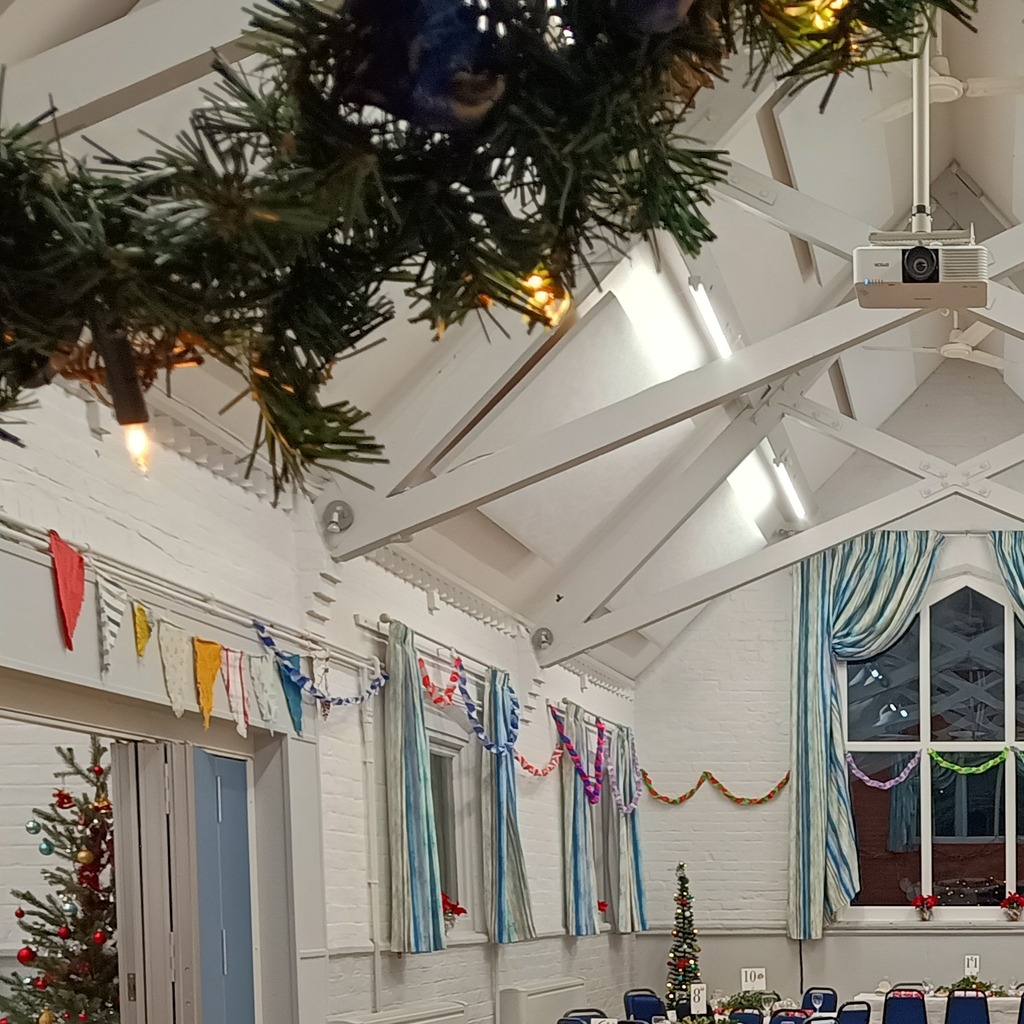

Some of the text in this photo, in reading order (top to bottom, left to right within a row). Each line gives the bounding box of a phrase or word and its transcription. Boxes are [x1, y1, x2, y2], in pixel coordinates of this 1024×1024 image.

[966, 957, 977, 968] 11
[744, 970, 756, 982] 10
[693, 988, 700, 1003] 8
